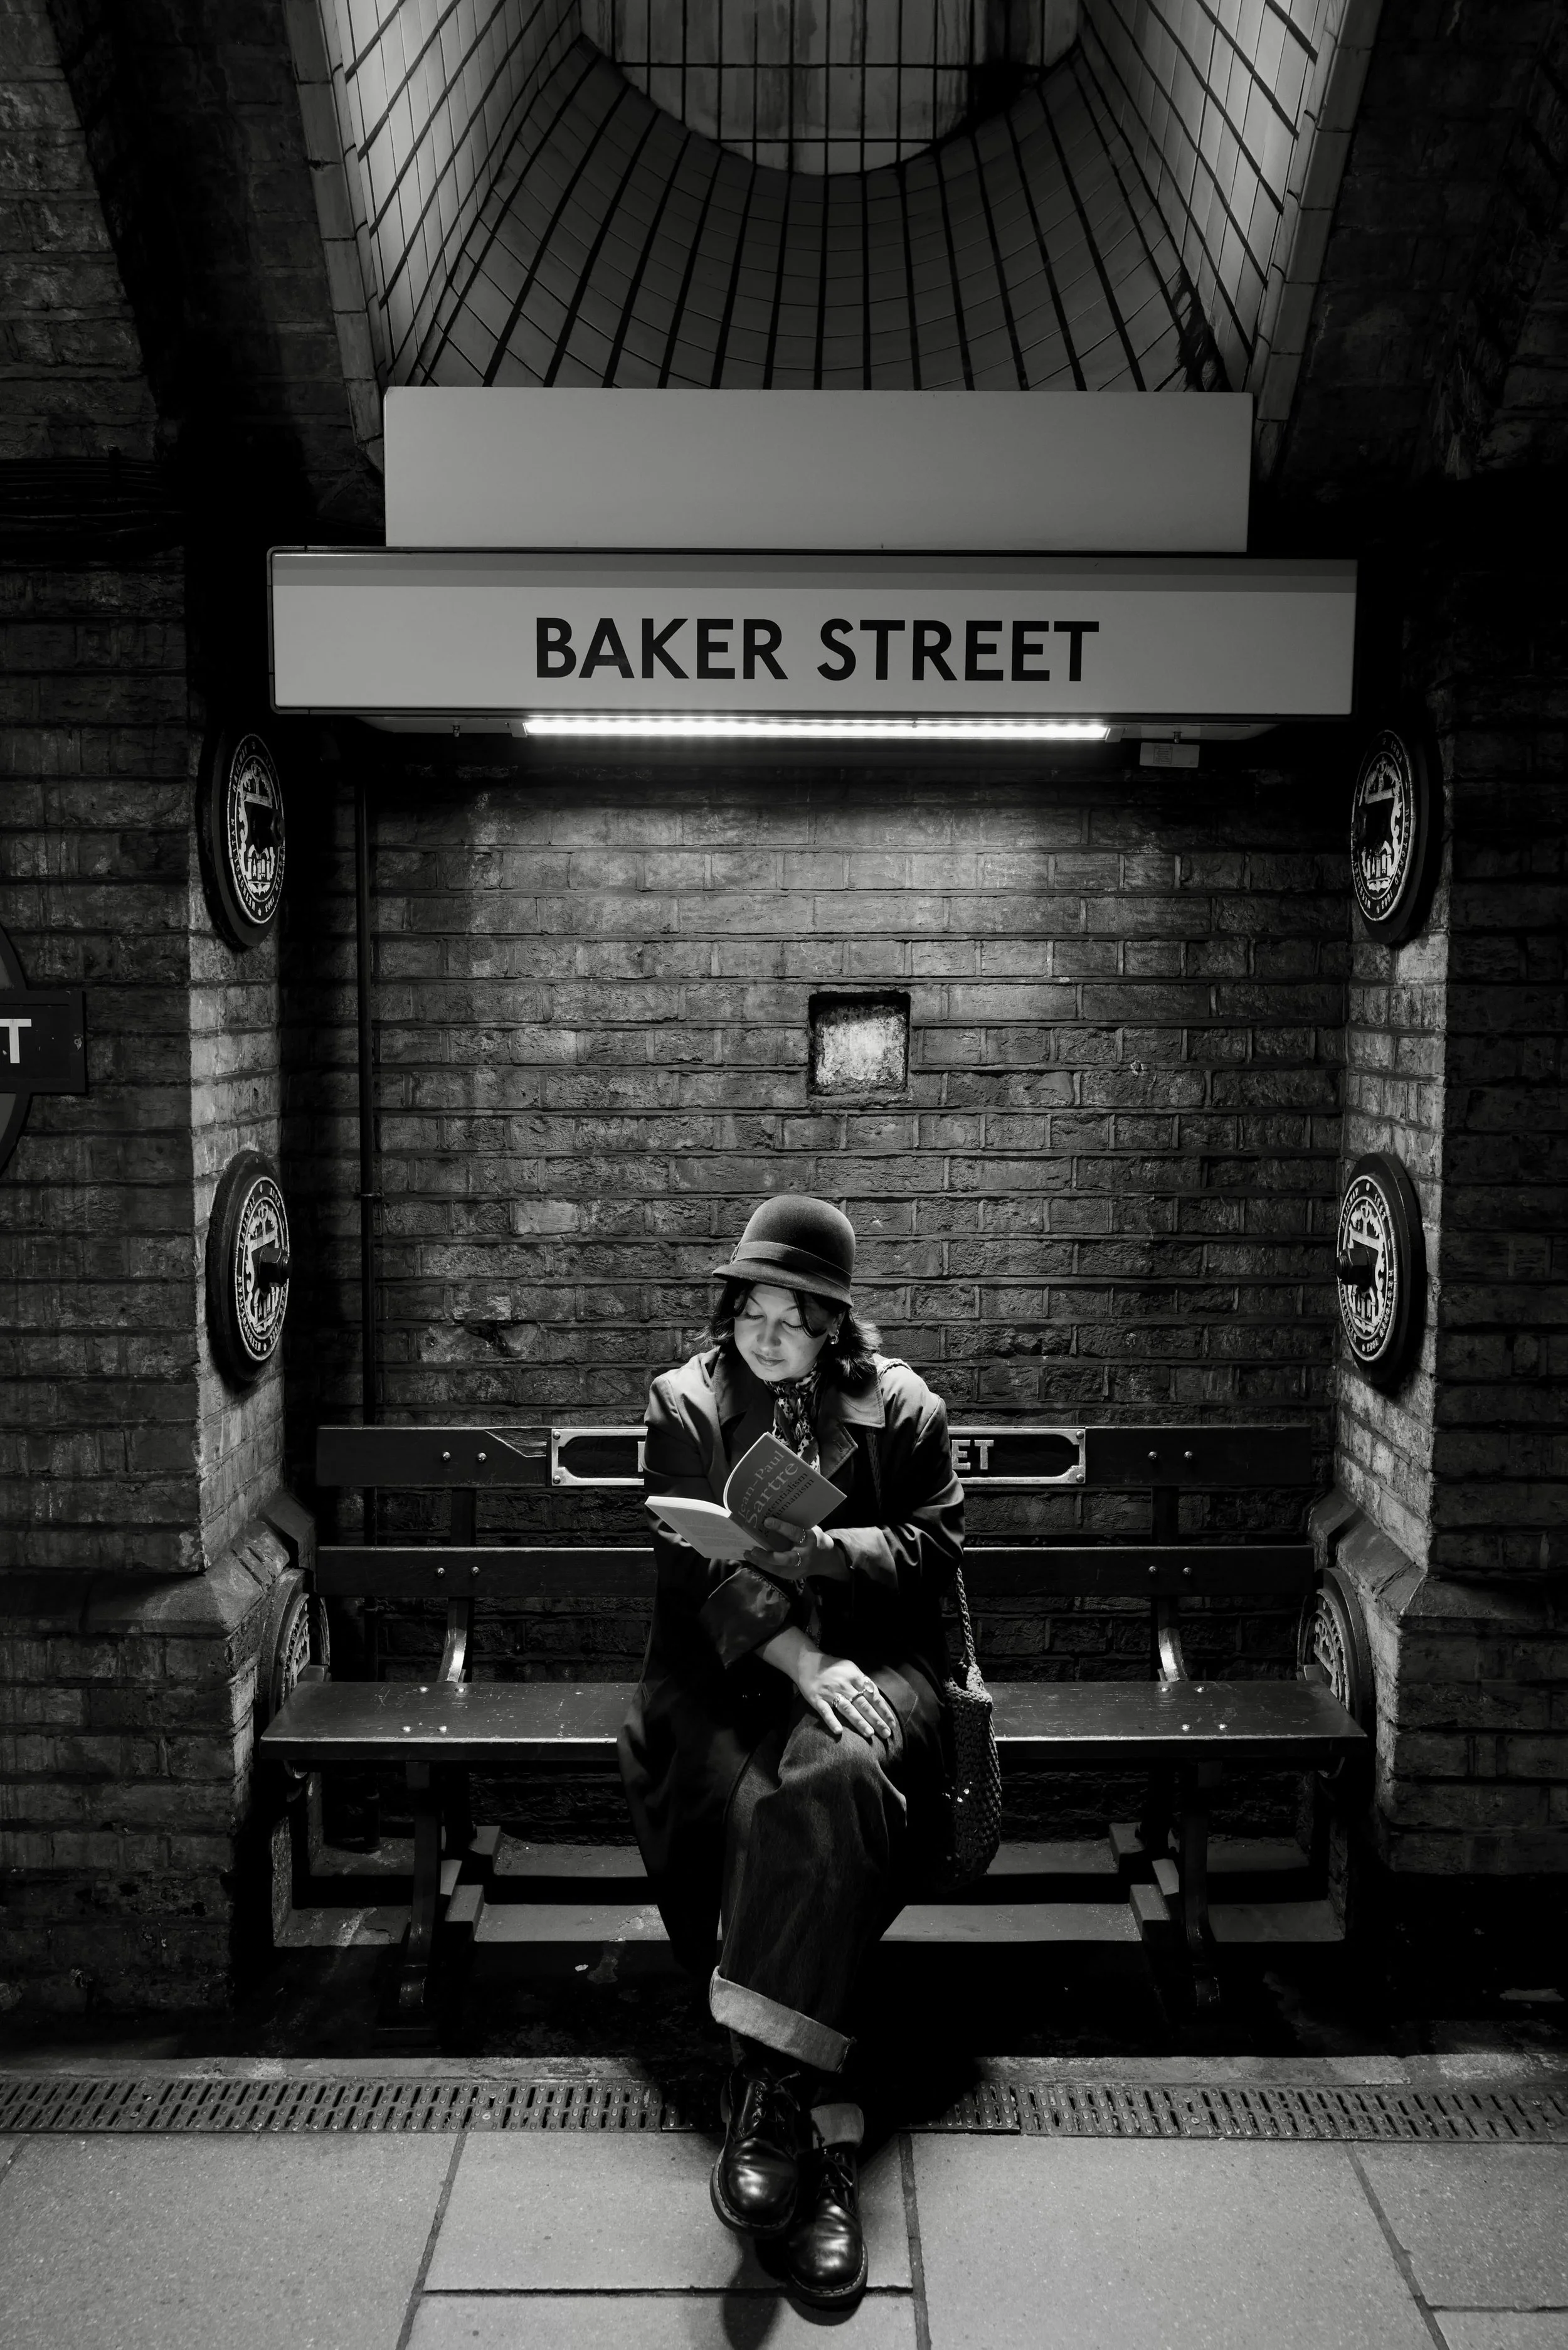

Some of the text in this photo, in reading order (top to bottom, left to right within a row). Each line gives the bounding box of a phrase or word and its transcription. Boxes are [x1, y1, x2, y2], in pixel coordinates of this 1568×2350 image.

[536, 617, 1099, 681] BAKER STREET
[738, 1450, 785, 1519] Jean-Paul
[746, 1463, 798, 1528] Sartre
